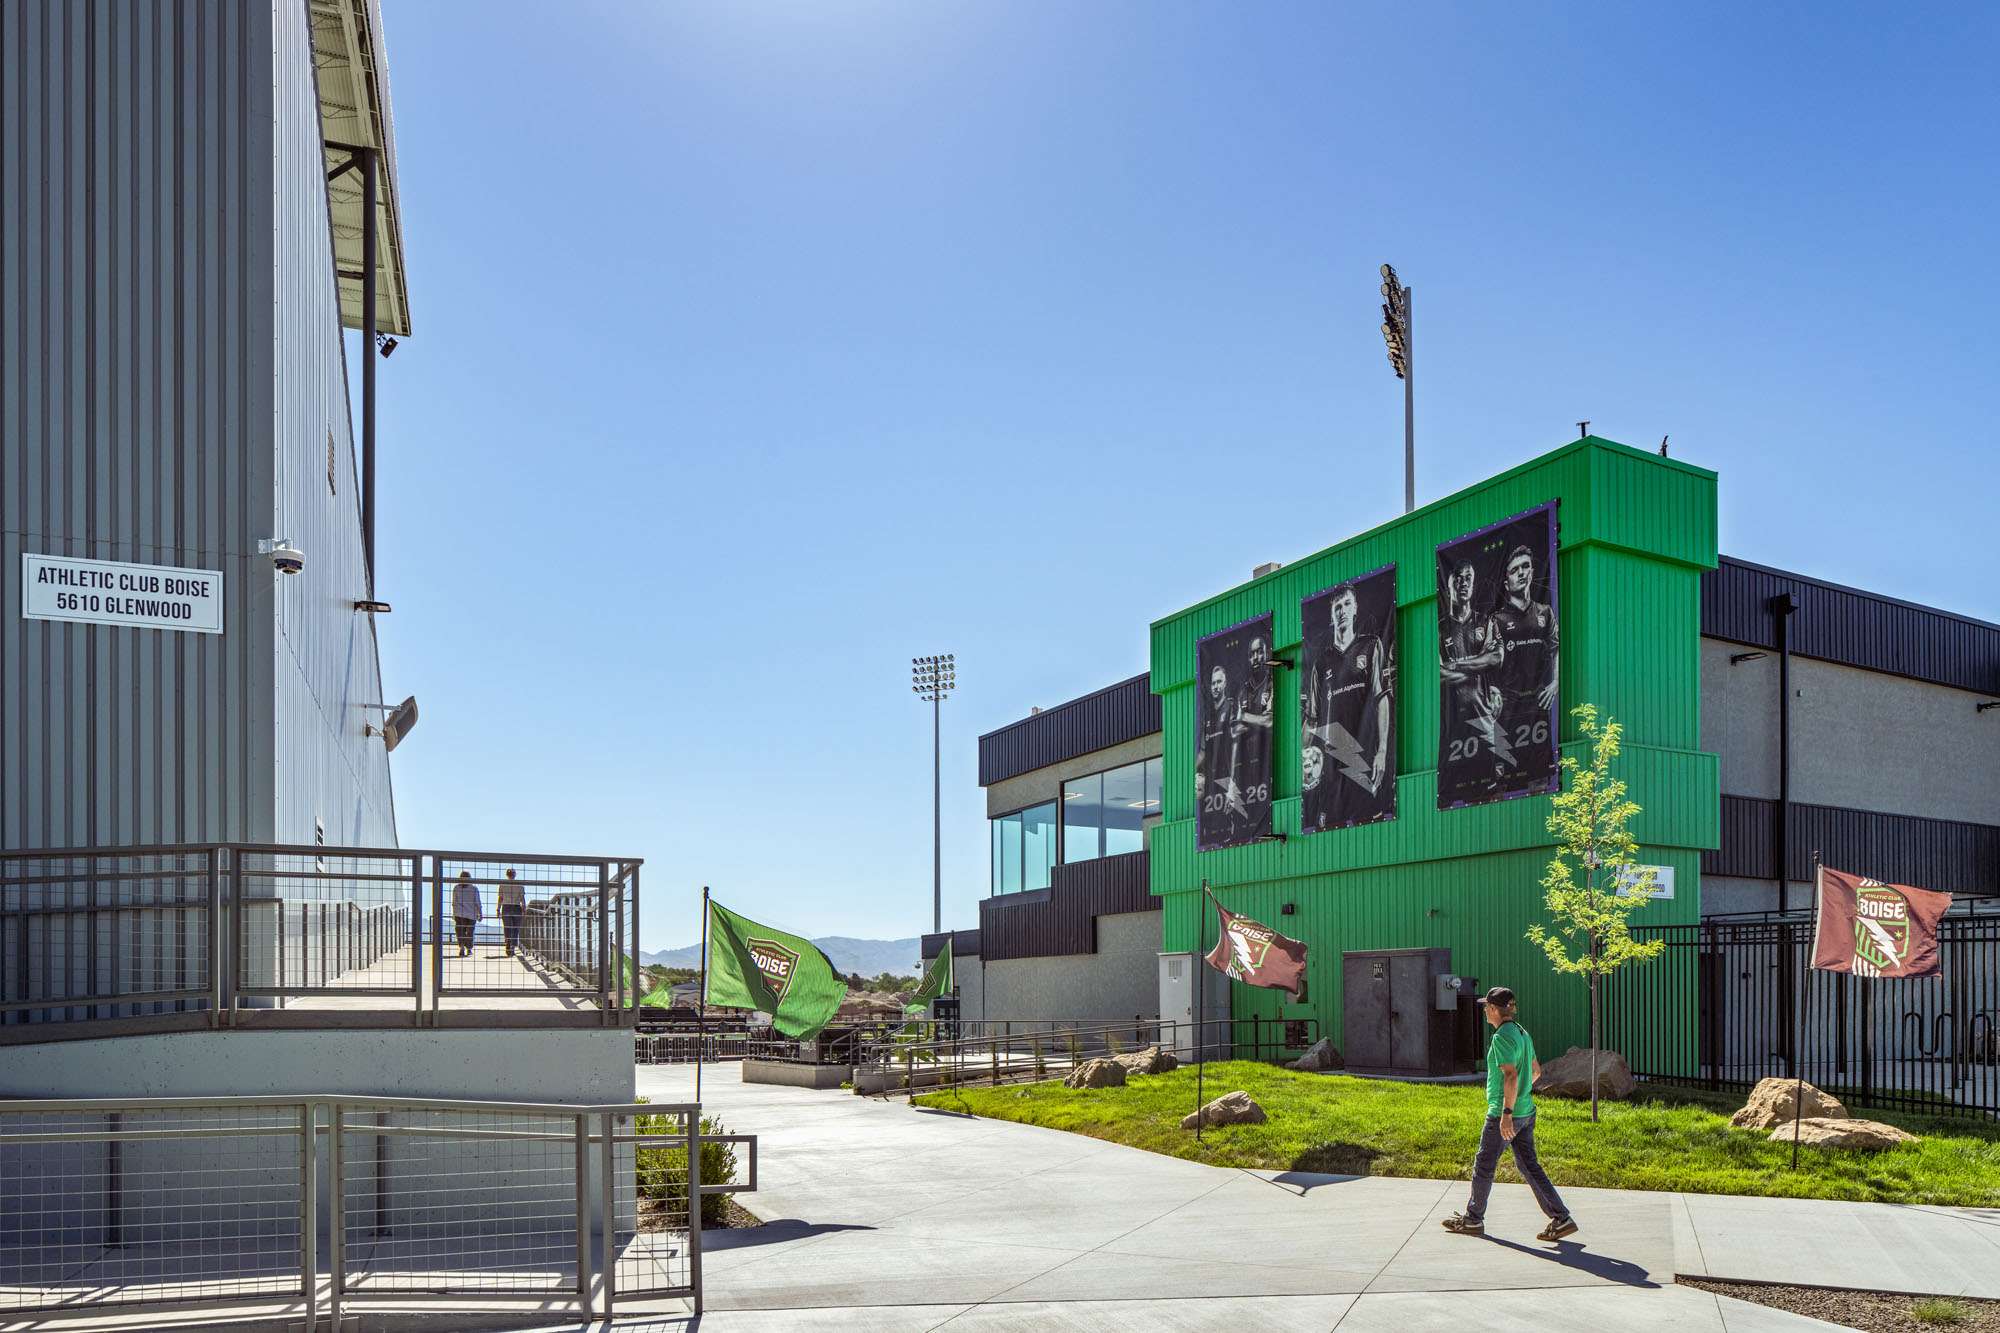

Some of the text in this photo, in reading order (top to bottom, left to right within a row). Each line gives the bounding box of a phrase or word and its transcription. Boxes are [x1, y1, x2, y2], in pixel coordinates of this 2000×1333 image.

[38, 567, 210, 598] ATHLETIC CLUB BOISE
[57, 593, 192, 620] 5610 GLENWOOD
[1448, 720, 1549, 762] 20 26
[1205, 783, 1267, 813] 20 26
[1859, 898, 1905, 919] BOISE
